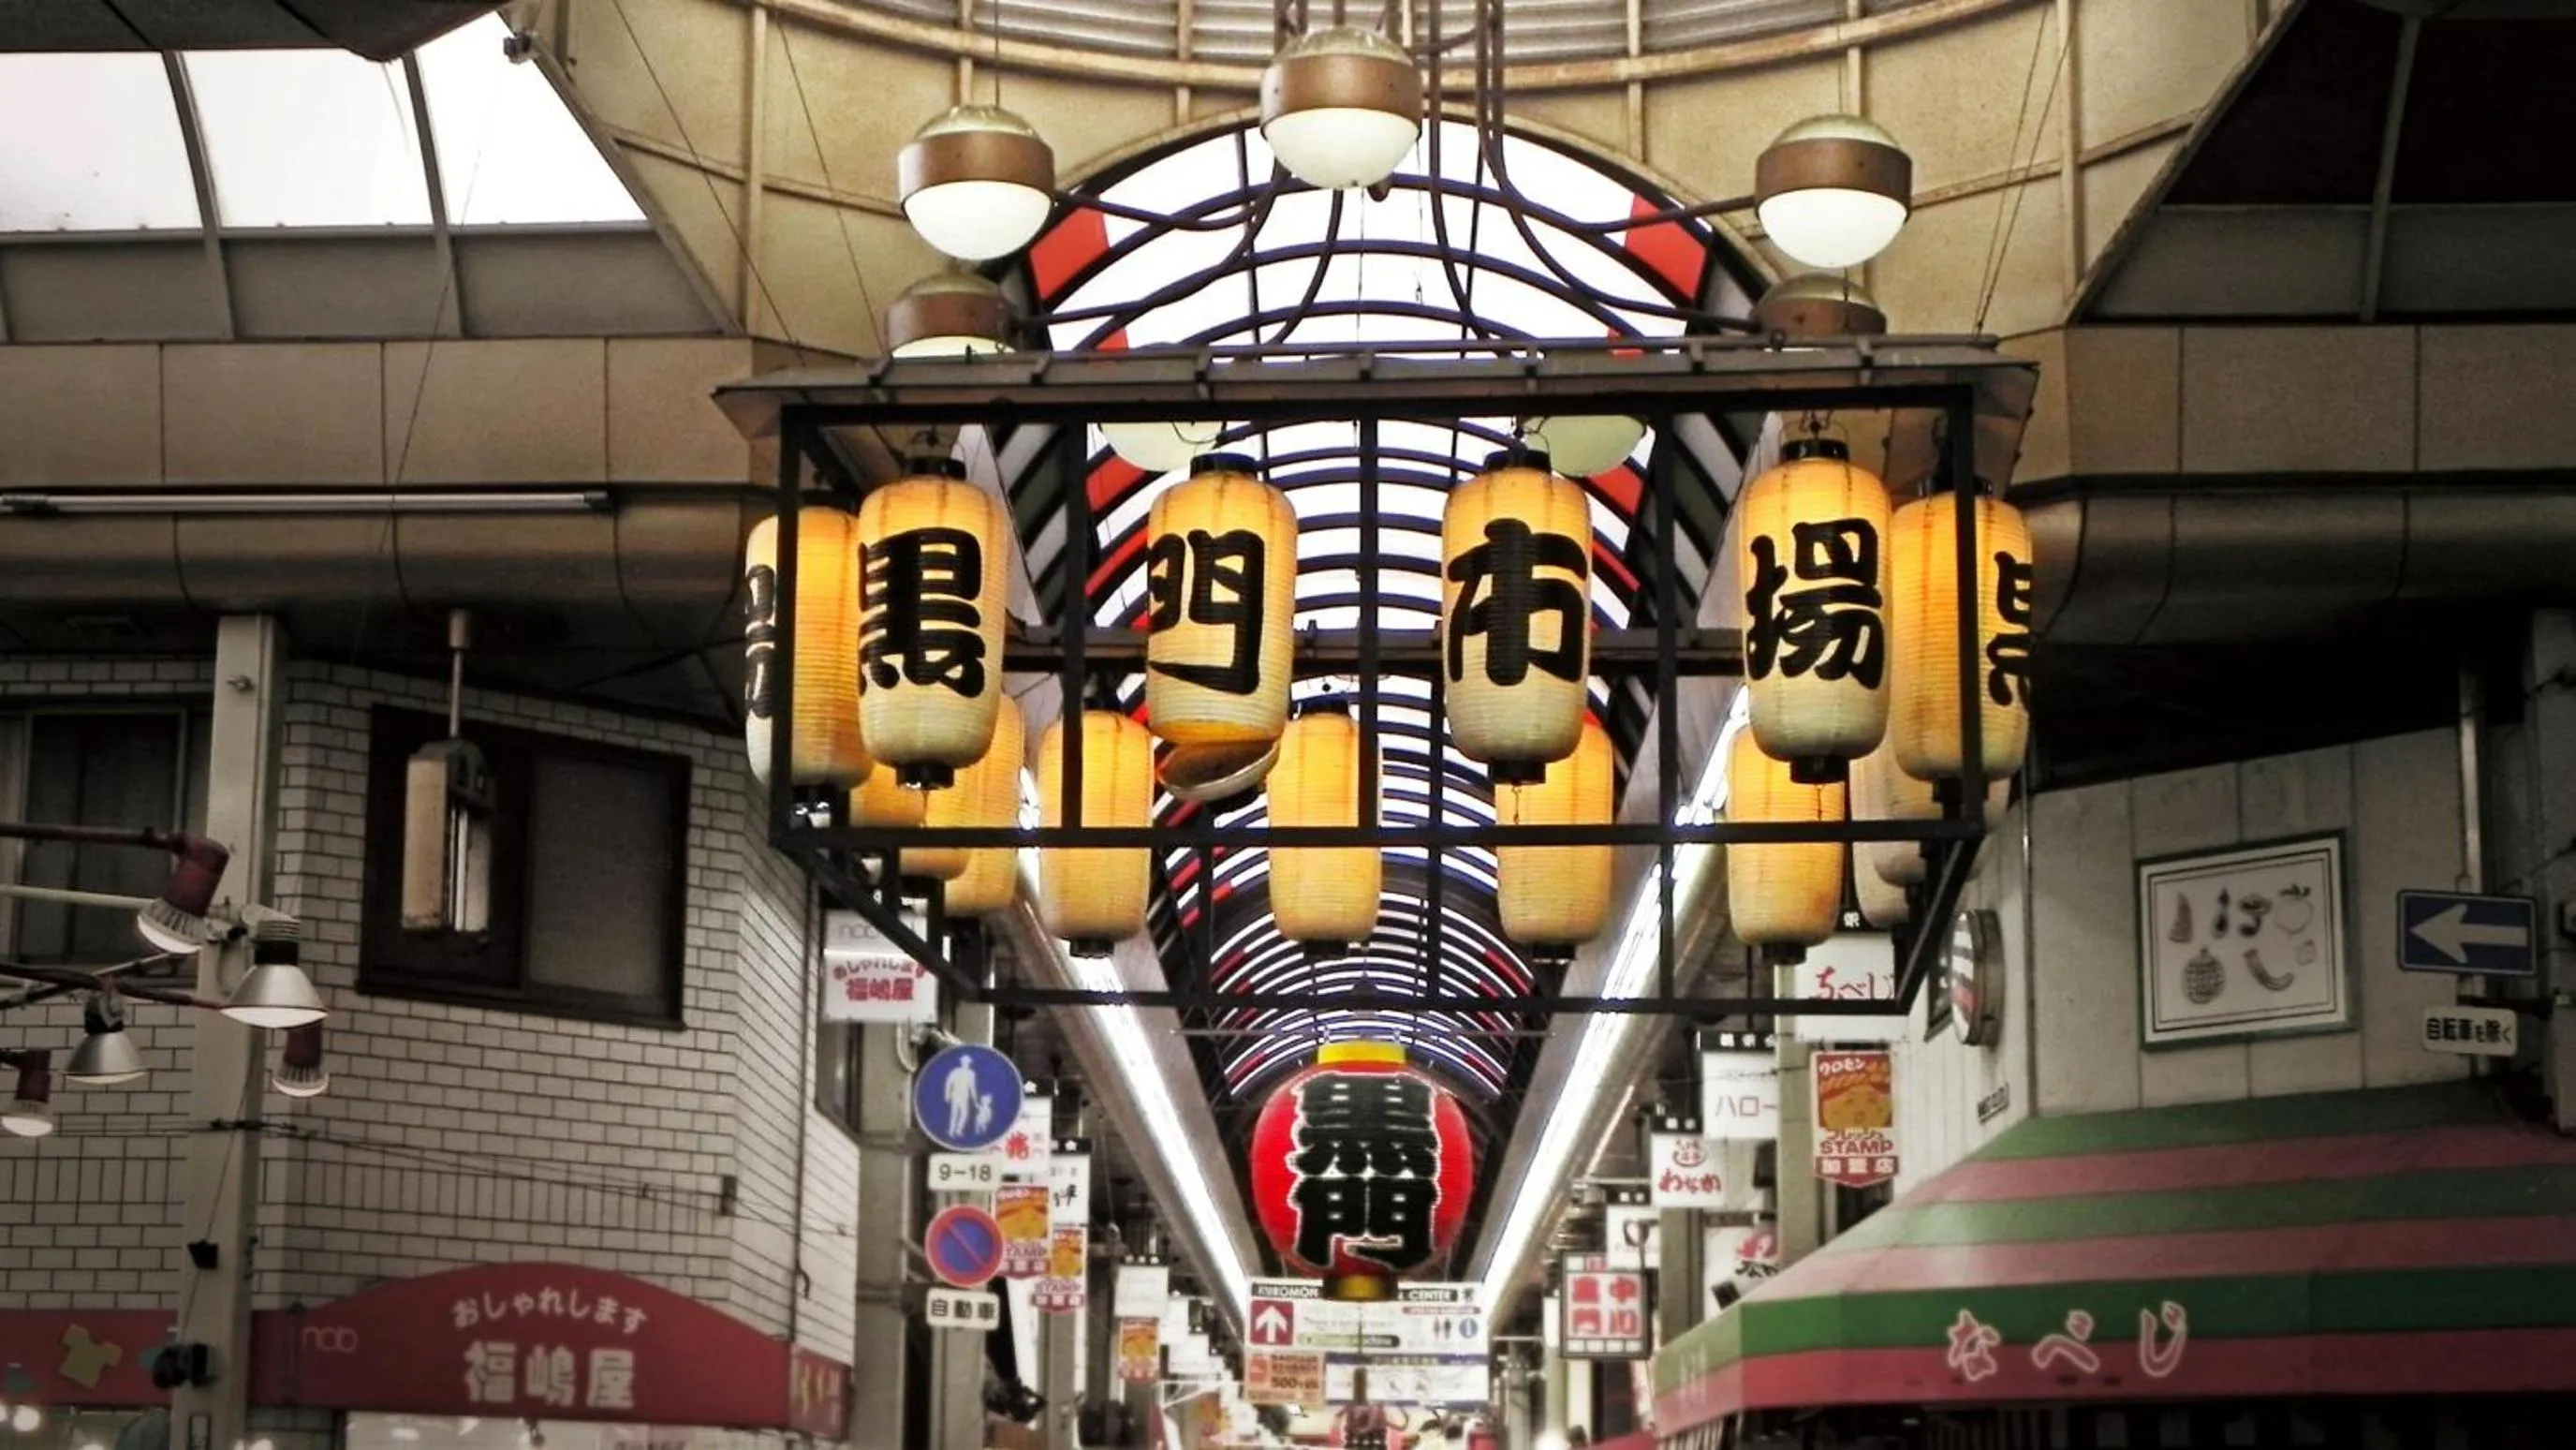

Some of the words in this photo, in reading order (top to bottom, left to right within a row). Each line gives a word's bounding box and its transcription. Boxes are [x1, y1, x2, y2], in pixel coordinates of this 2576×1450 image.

[1447, 517, 1588, 687] 市
[2426, 1017, 2512, 1044] 自転車を除く
[1820, 1140, 1893, 1155] STAMP
[453, 1287, 646, 1334] おしゃれします
[932, 1299, 995, 1320] 自動車
[464, 1339, 636, 1409] 福嶋屋
